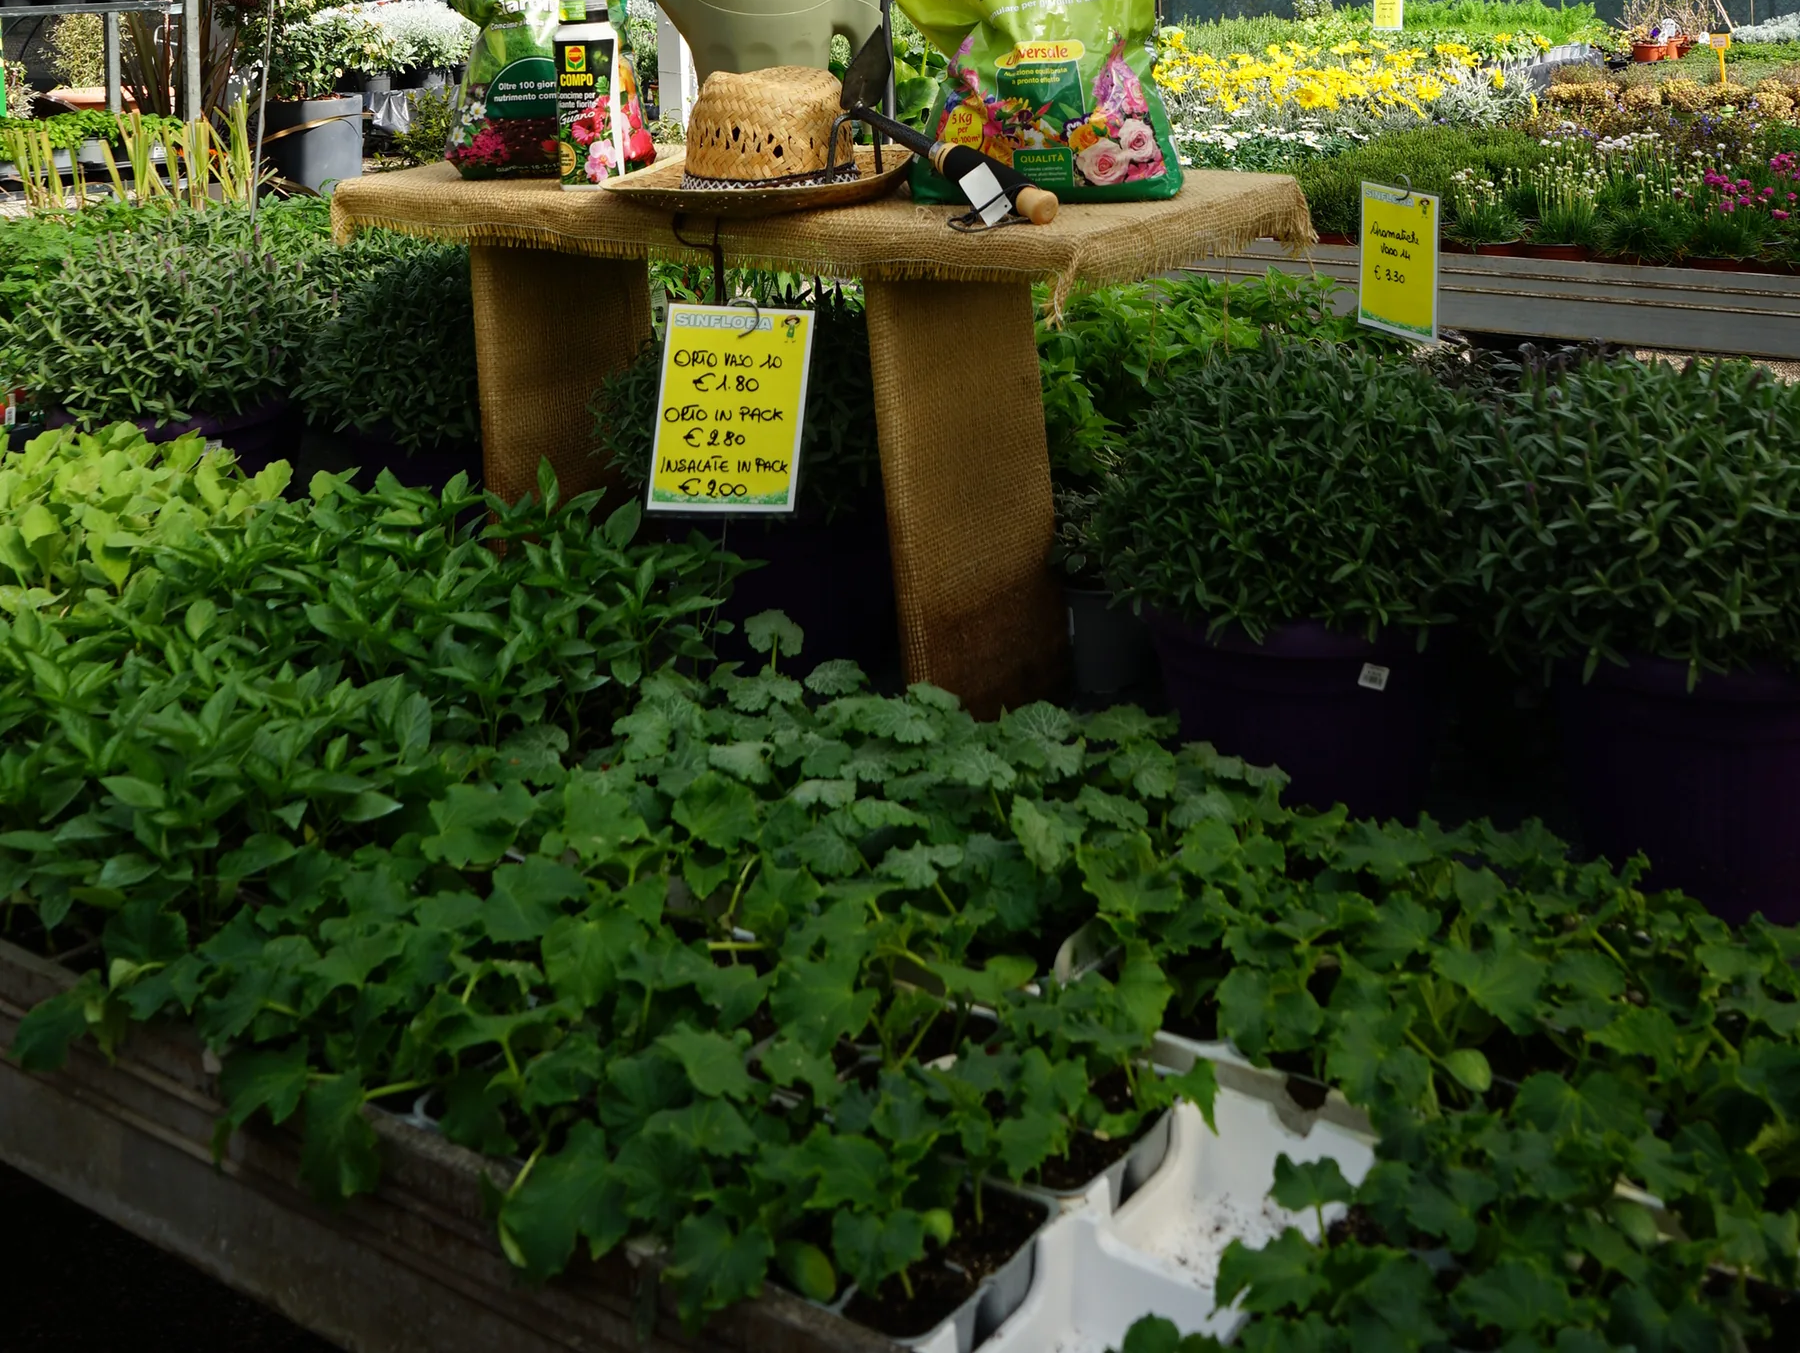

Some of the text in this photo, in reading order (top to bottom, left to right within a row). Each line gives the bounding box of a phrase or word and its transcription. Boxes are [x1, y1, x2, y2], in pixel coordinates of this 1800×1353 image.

[498, 80, 517, 91] Oltre
[519, 80, 535, 89] 100
[559, 73, 594, 87] COMPO
[493, 91, 537, 102] nutrimento
[584, 92, 596, 101] per
[558, 101, 576, 109] iante
[559, 111, 596, 126] Guano
[952, 112, 973, 125] 5 Kg
[957, 126, 969, 136] per
[1020, 152, 1065, 164] QUALITÀ
[674, 349, 718, 368] ORTO
[759, 353, 782, 368] 10
[715, 374, 759, 392] 1.80
[664, 404, 783, 423] ORTO IN PACK
[660, 455, 788, 475] INSALATE IN PACK
